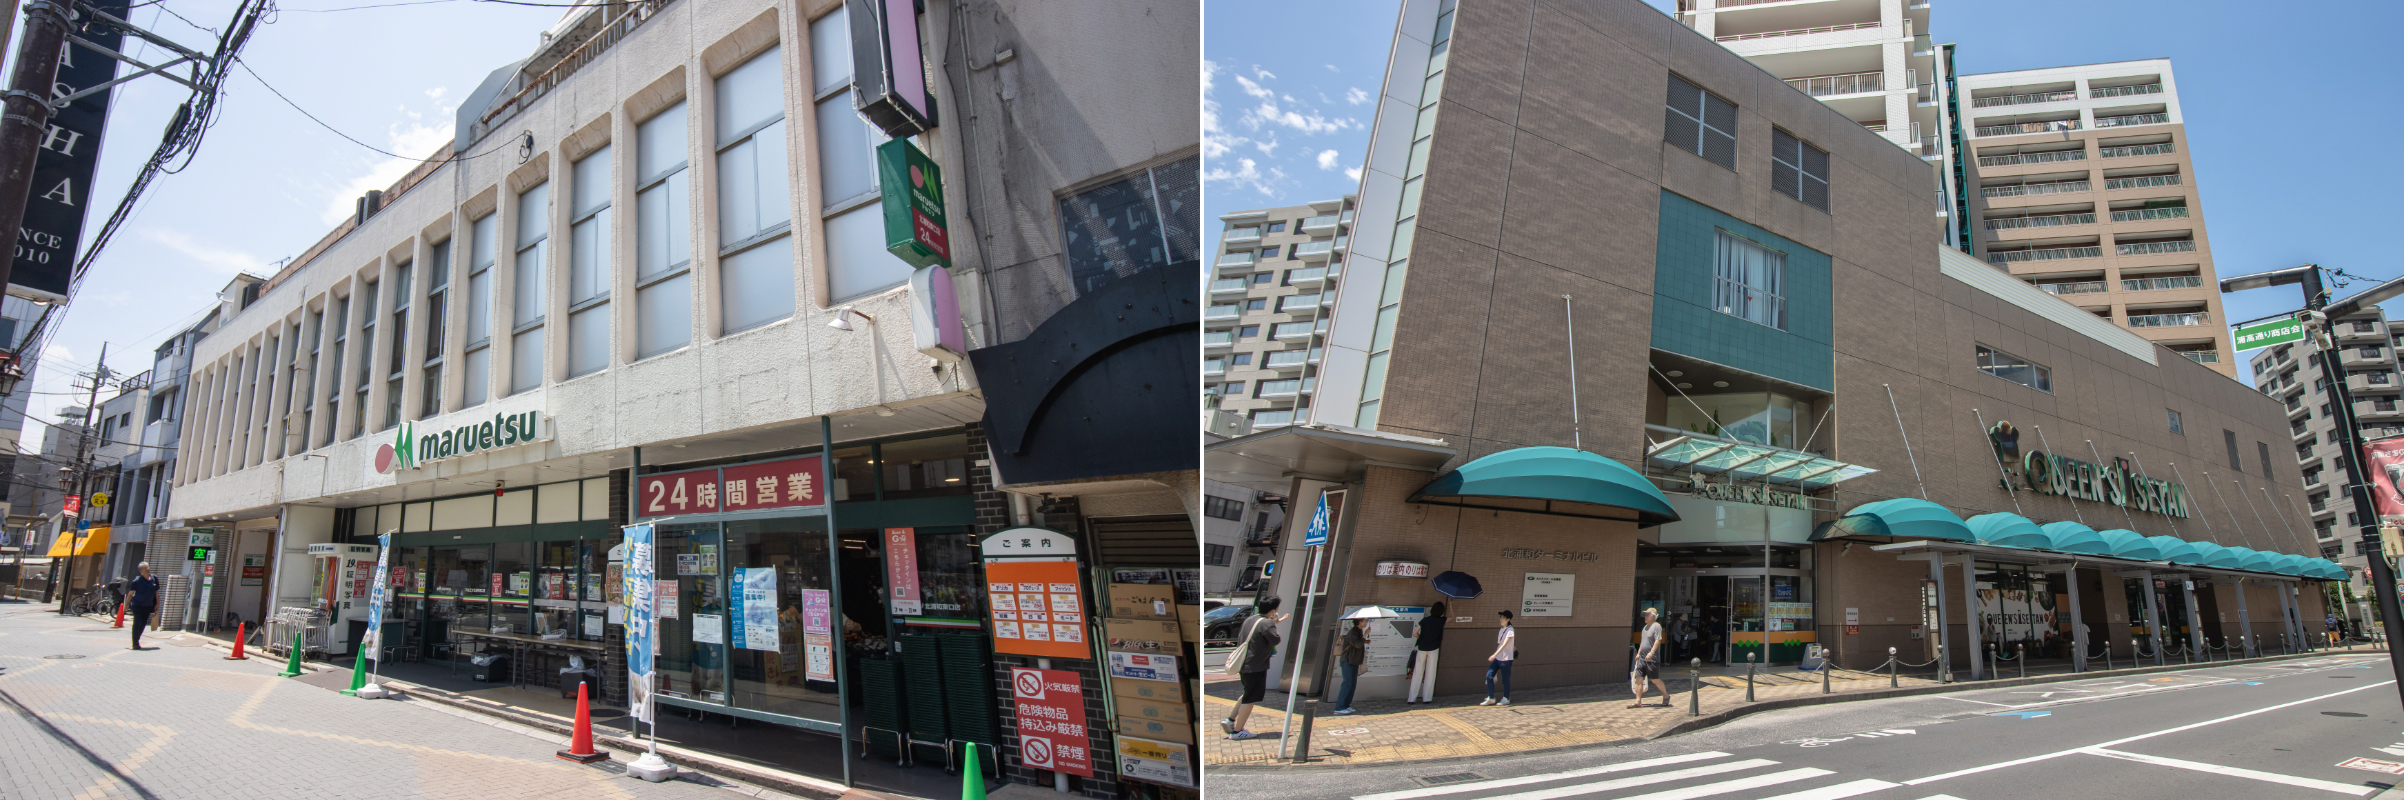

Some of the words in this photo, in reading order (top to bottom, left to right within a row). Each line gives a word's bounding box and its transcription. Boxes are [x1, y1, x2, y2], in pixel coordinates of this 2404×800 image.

[913, 188, 941, 216] maruetsu
[2236, 325, 2301, 345] 浦高通り商店会
[419, 411, 537, 462] maruetsu
[2025, 450, 2122, 506] QUEEN'S
[649, 472, 813, 512] 24時間営業
[1002, 538, 1052, 548] ご案内
[194, 548, 206, 559] 空
[1502, 548, 1599, 562] 北浦和ターミナルビル
[343, 570, 355, 610] 証明写真
[1044, 682, 1081, 694] 火気厳禁
[1018, 703, 1068, 720] 危険物品
[1020, 717, 1084, 737] 持込み厳禁
[1056, 744, 1086, 760] 禁煙
